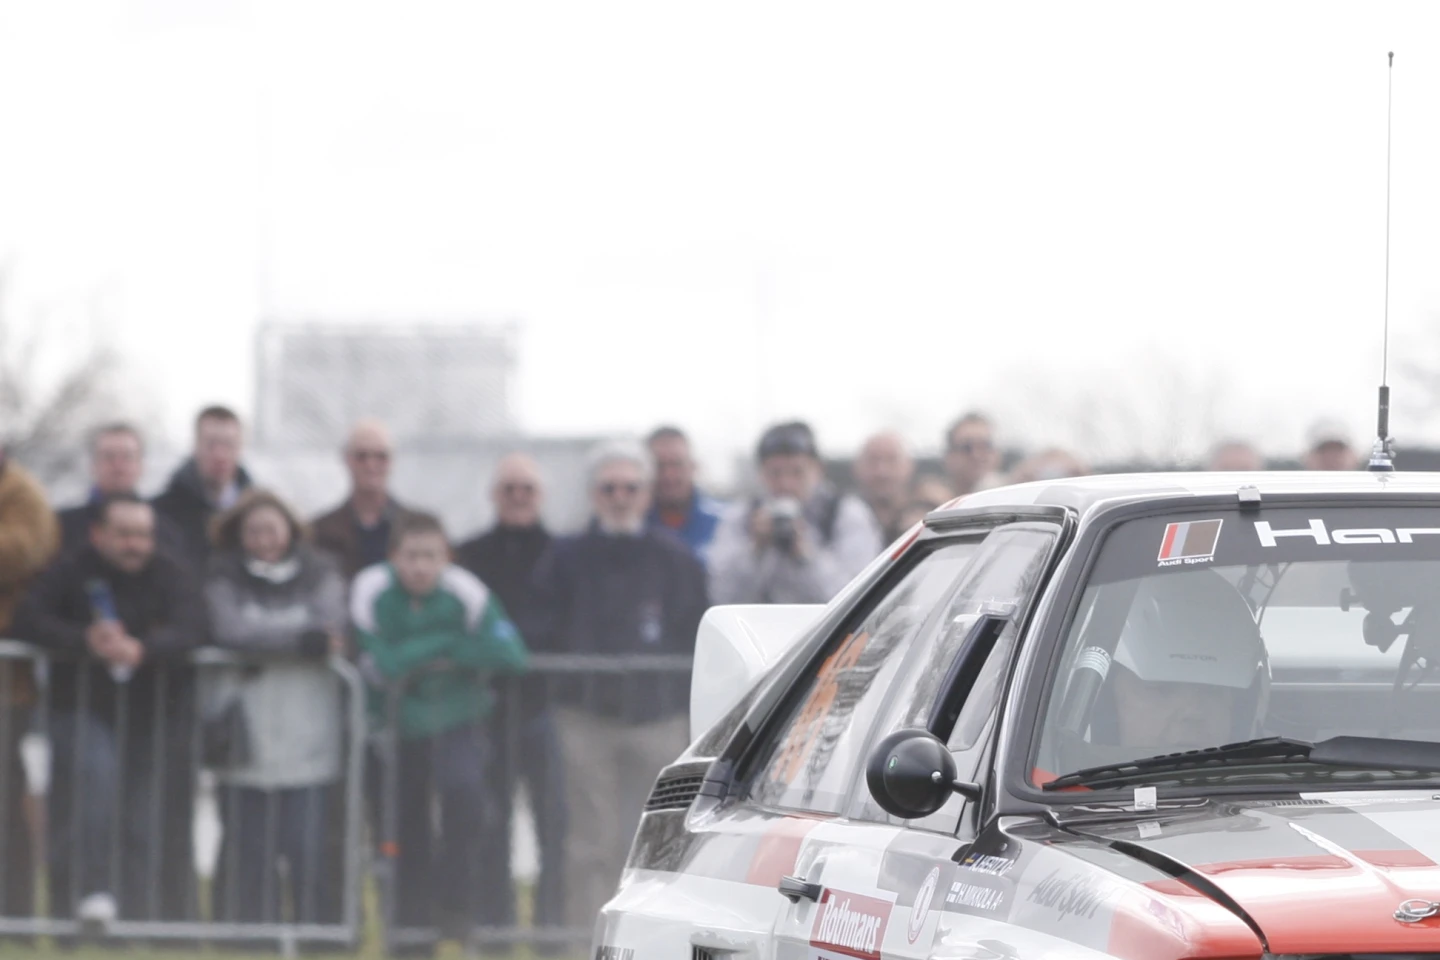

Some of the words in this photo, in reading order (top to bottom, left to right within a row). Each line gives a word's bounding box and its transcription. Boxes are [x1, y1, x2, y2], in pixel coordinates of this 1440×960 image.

[1157, 558, 1183, 567] Audi
[1184, 556, 1215, 566] Sport
[817, 894, 882, 954] Rothmans
